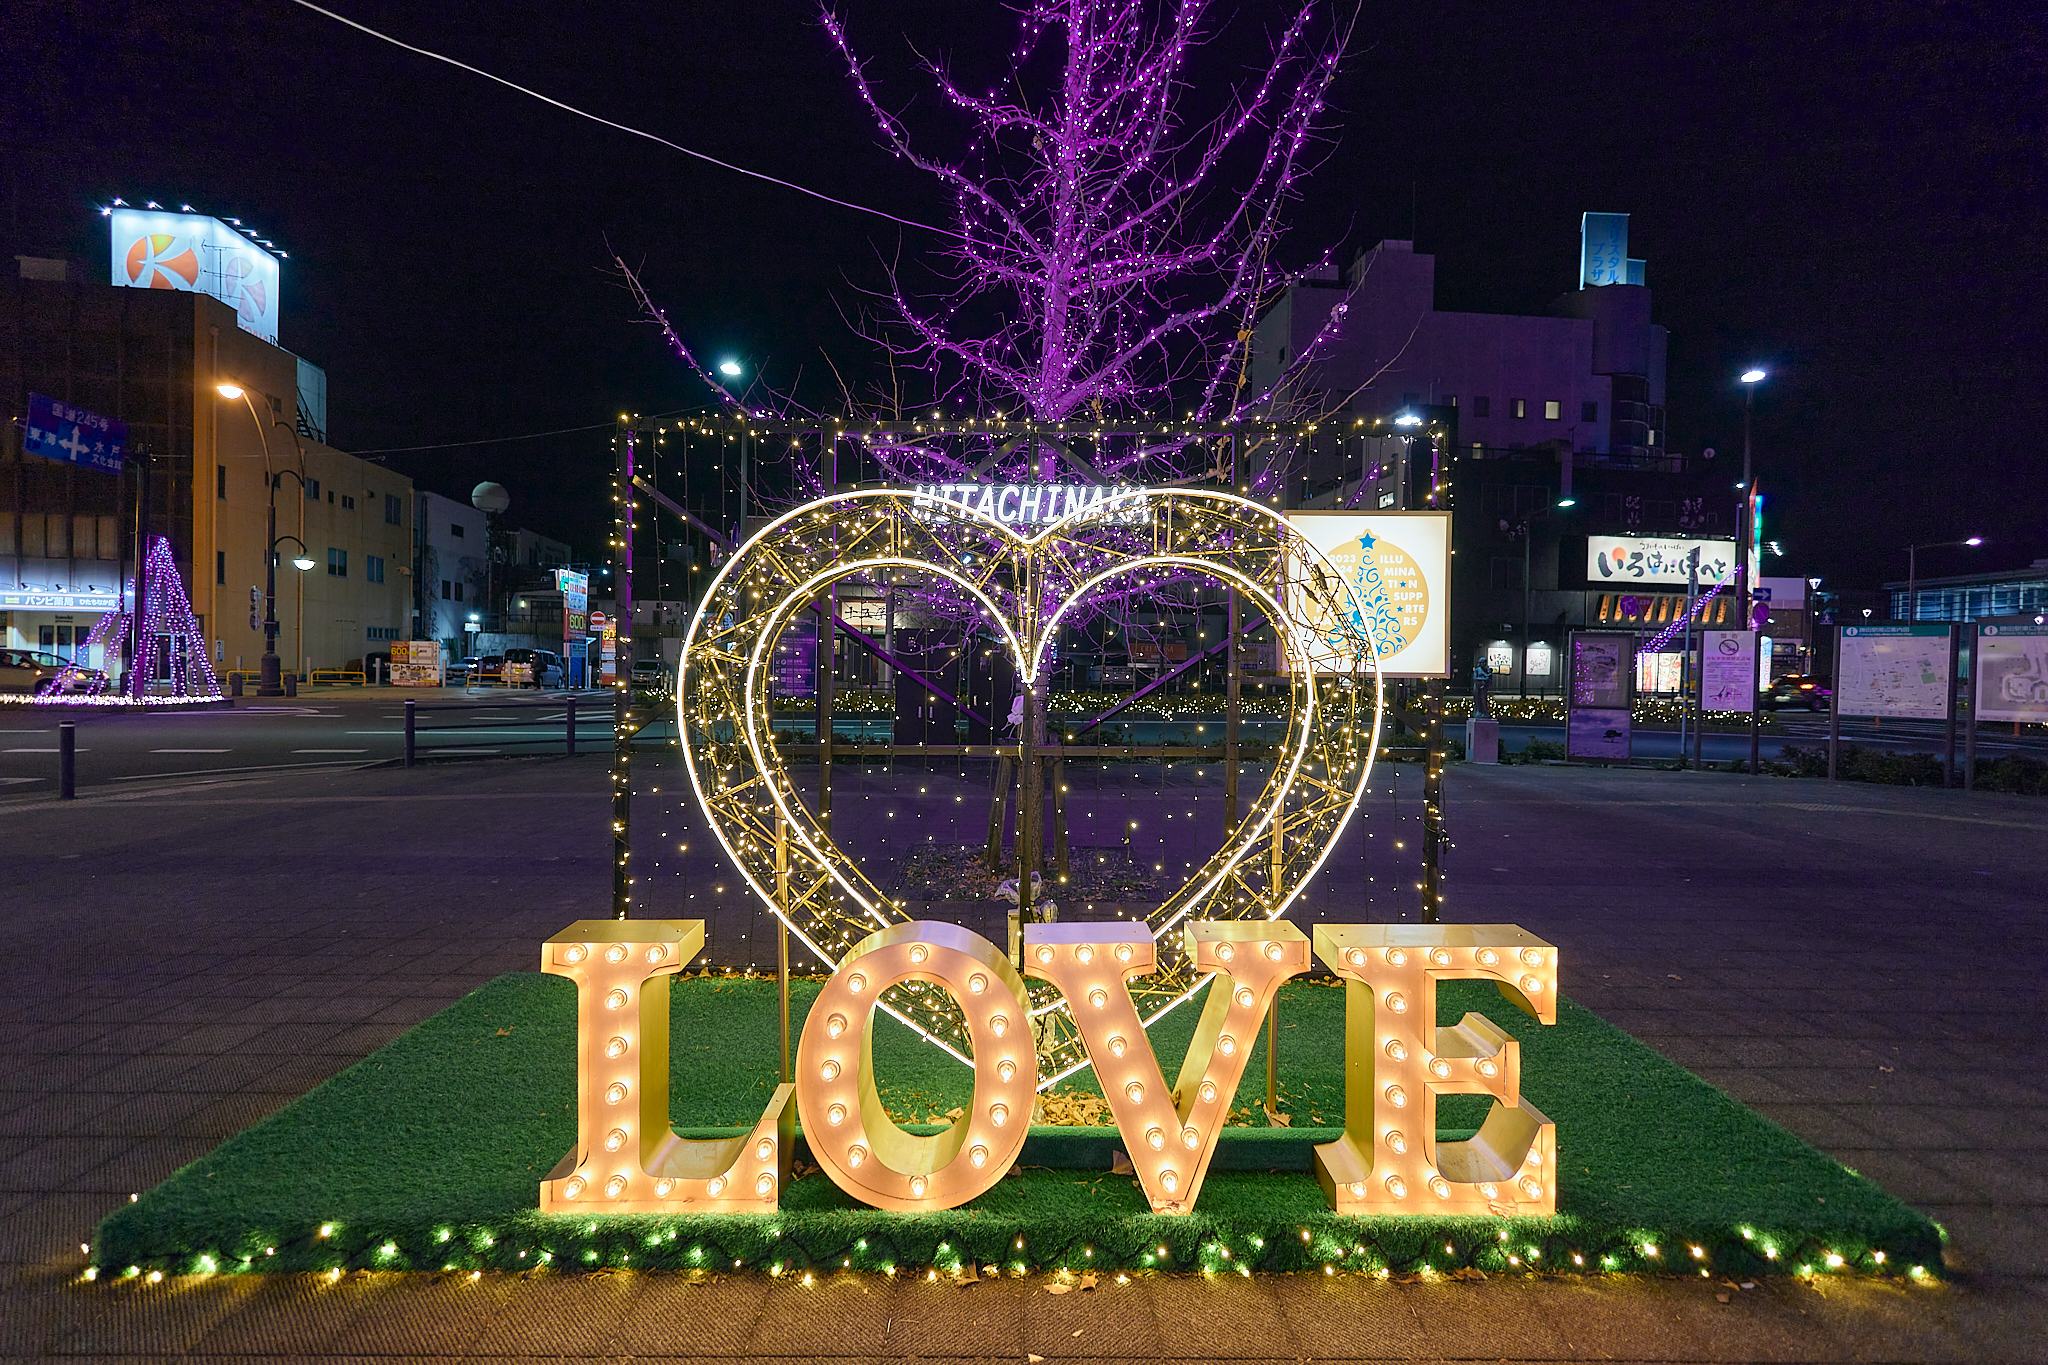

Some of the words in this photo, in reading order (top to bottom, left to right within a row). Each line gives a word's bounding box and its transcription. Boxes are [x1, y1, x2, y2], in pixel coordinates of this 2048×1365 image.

[1591, 243, 1605, 282] プラザ
[52, 403, 109, 432] 国道245号
[29, 426, 57, 446] 東海
[94, 441, 121, 456] 水戸
[91, 453, 122, 470] 文化会館
[912, 484, 1149, 525] HITACHINAKA
[1379, 555, 1404, 564] ILLU
[1326, 564, 1353, 574] 224
[1383, 567, 1416, 577] MINA
[25, 596, 74, 606] バンビ薬局
[1393, 591, 1424, 601] SUPP
[1403, 616, 1418, 626] RS
[538, 917, 1560, 1217] LOVE
